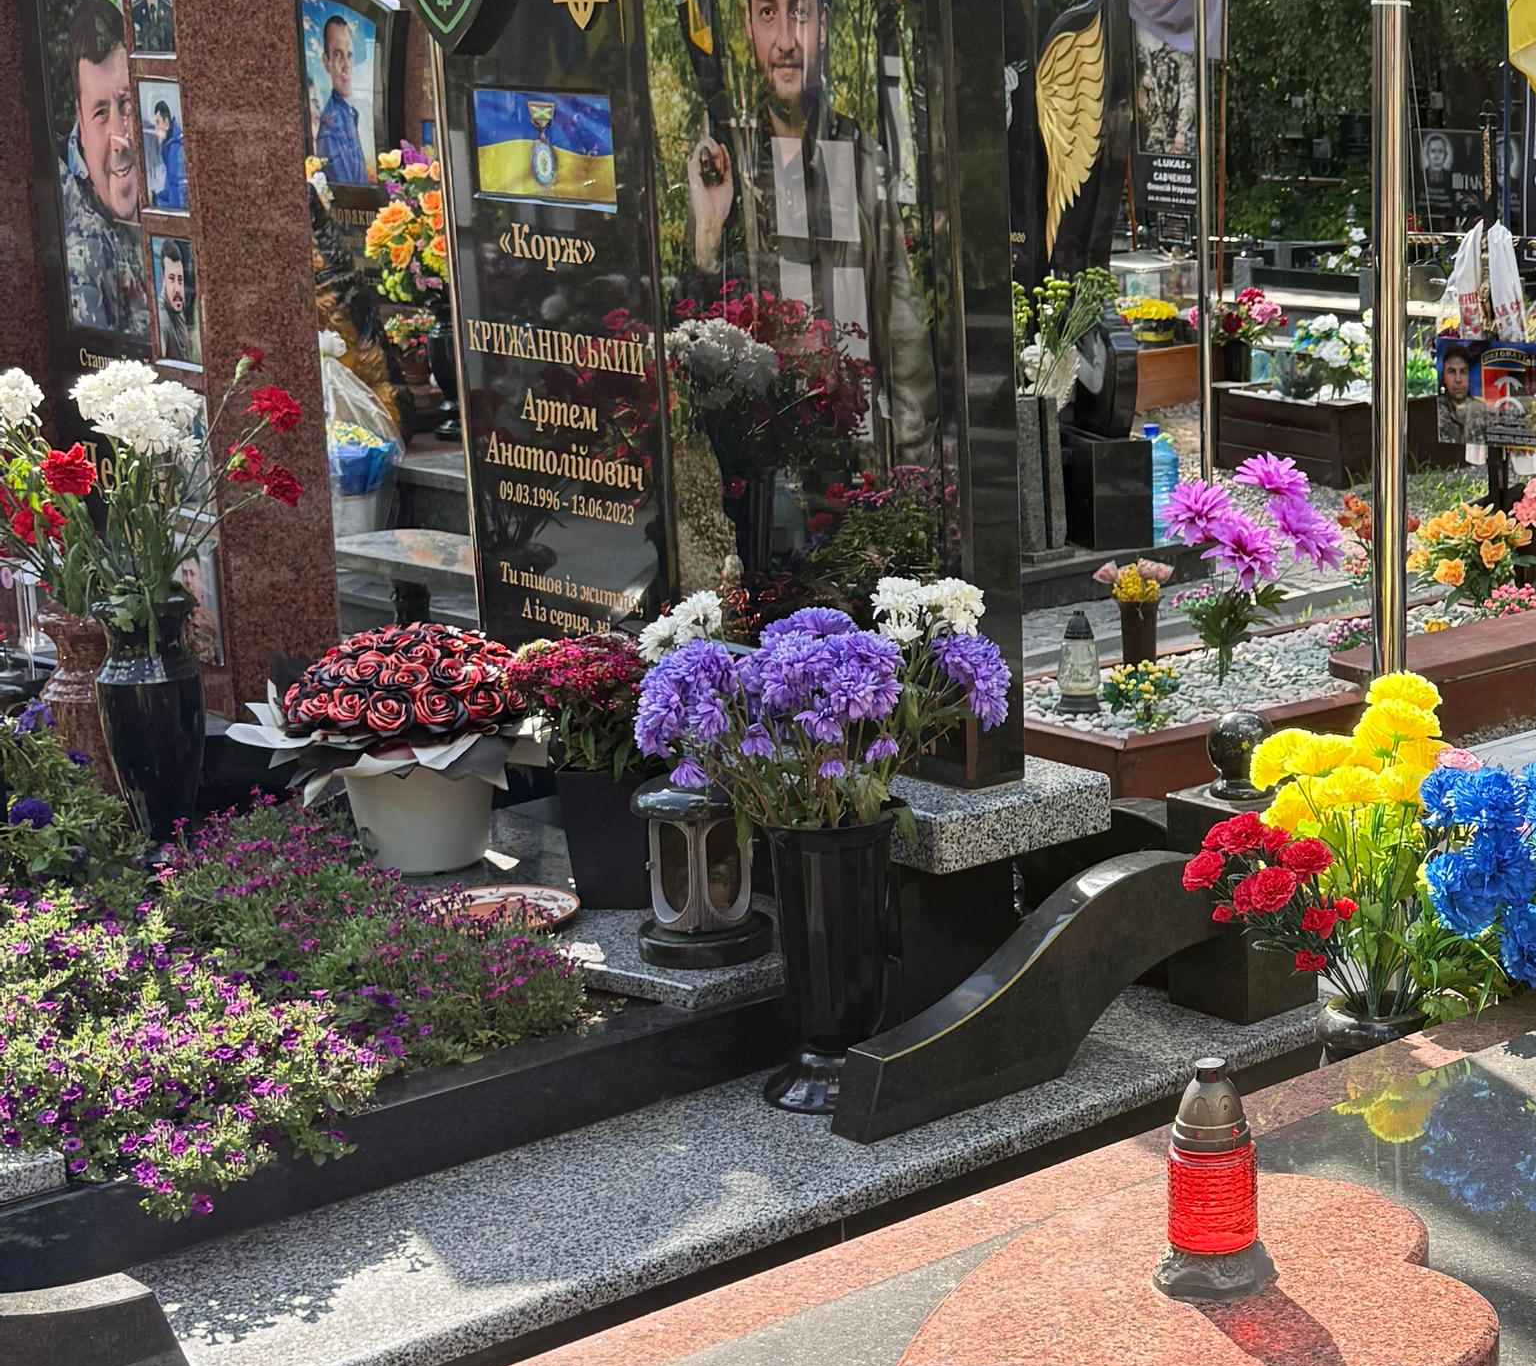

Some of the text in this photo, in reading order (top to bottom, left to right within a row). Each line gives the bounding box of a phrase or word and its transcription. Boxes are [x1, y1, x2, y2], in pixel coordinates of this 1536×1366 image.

[499, 222, 596, 272] «Корж»
[466, 318, 647, 377] КРИЖАНІВСЬКИЙ
[520, 387, 599, 433] Артем
[484, 430, 645, 493] Анатолійович
[499, 479, 561, 512] 09.03.1996
[571, 493, 636, 527] 13.06.2023
[499, 560, 519, 585] Ти
[520, 566, 564, 597] пішов
[565, 574, 578, 600] із
[521, 596, 533, 620] А
[534, 597, 547, 624] із
